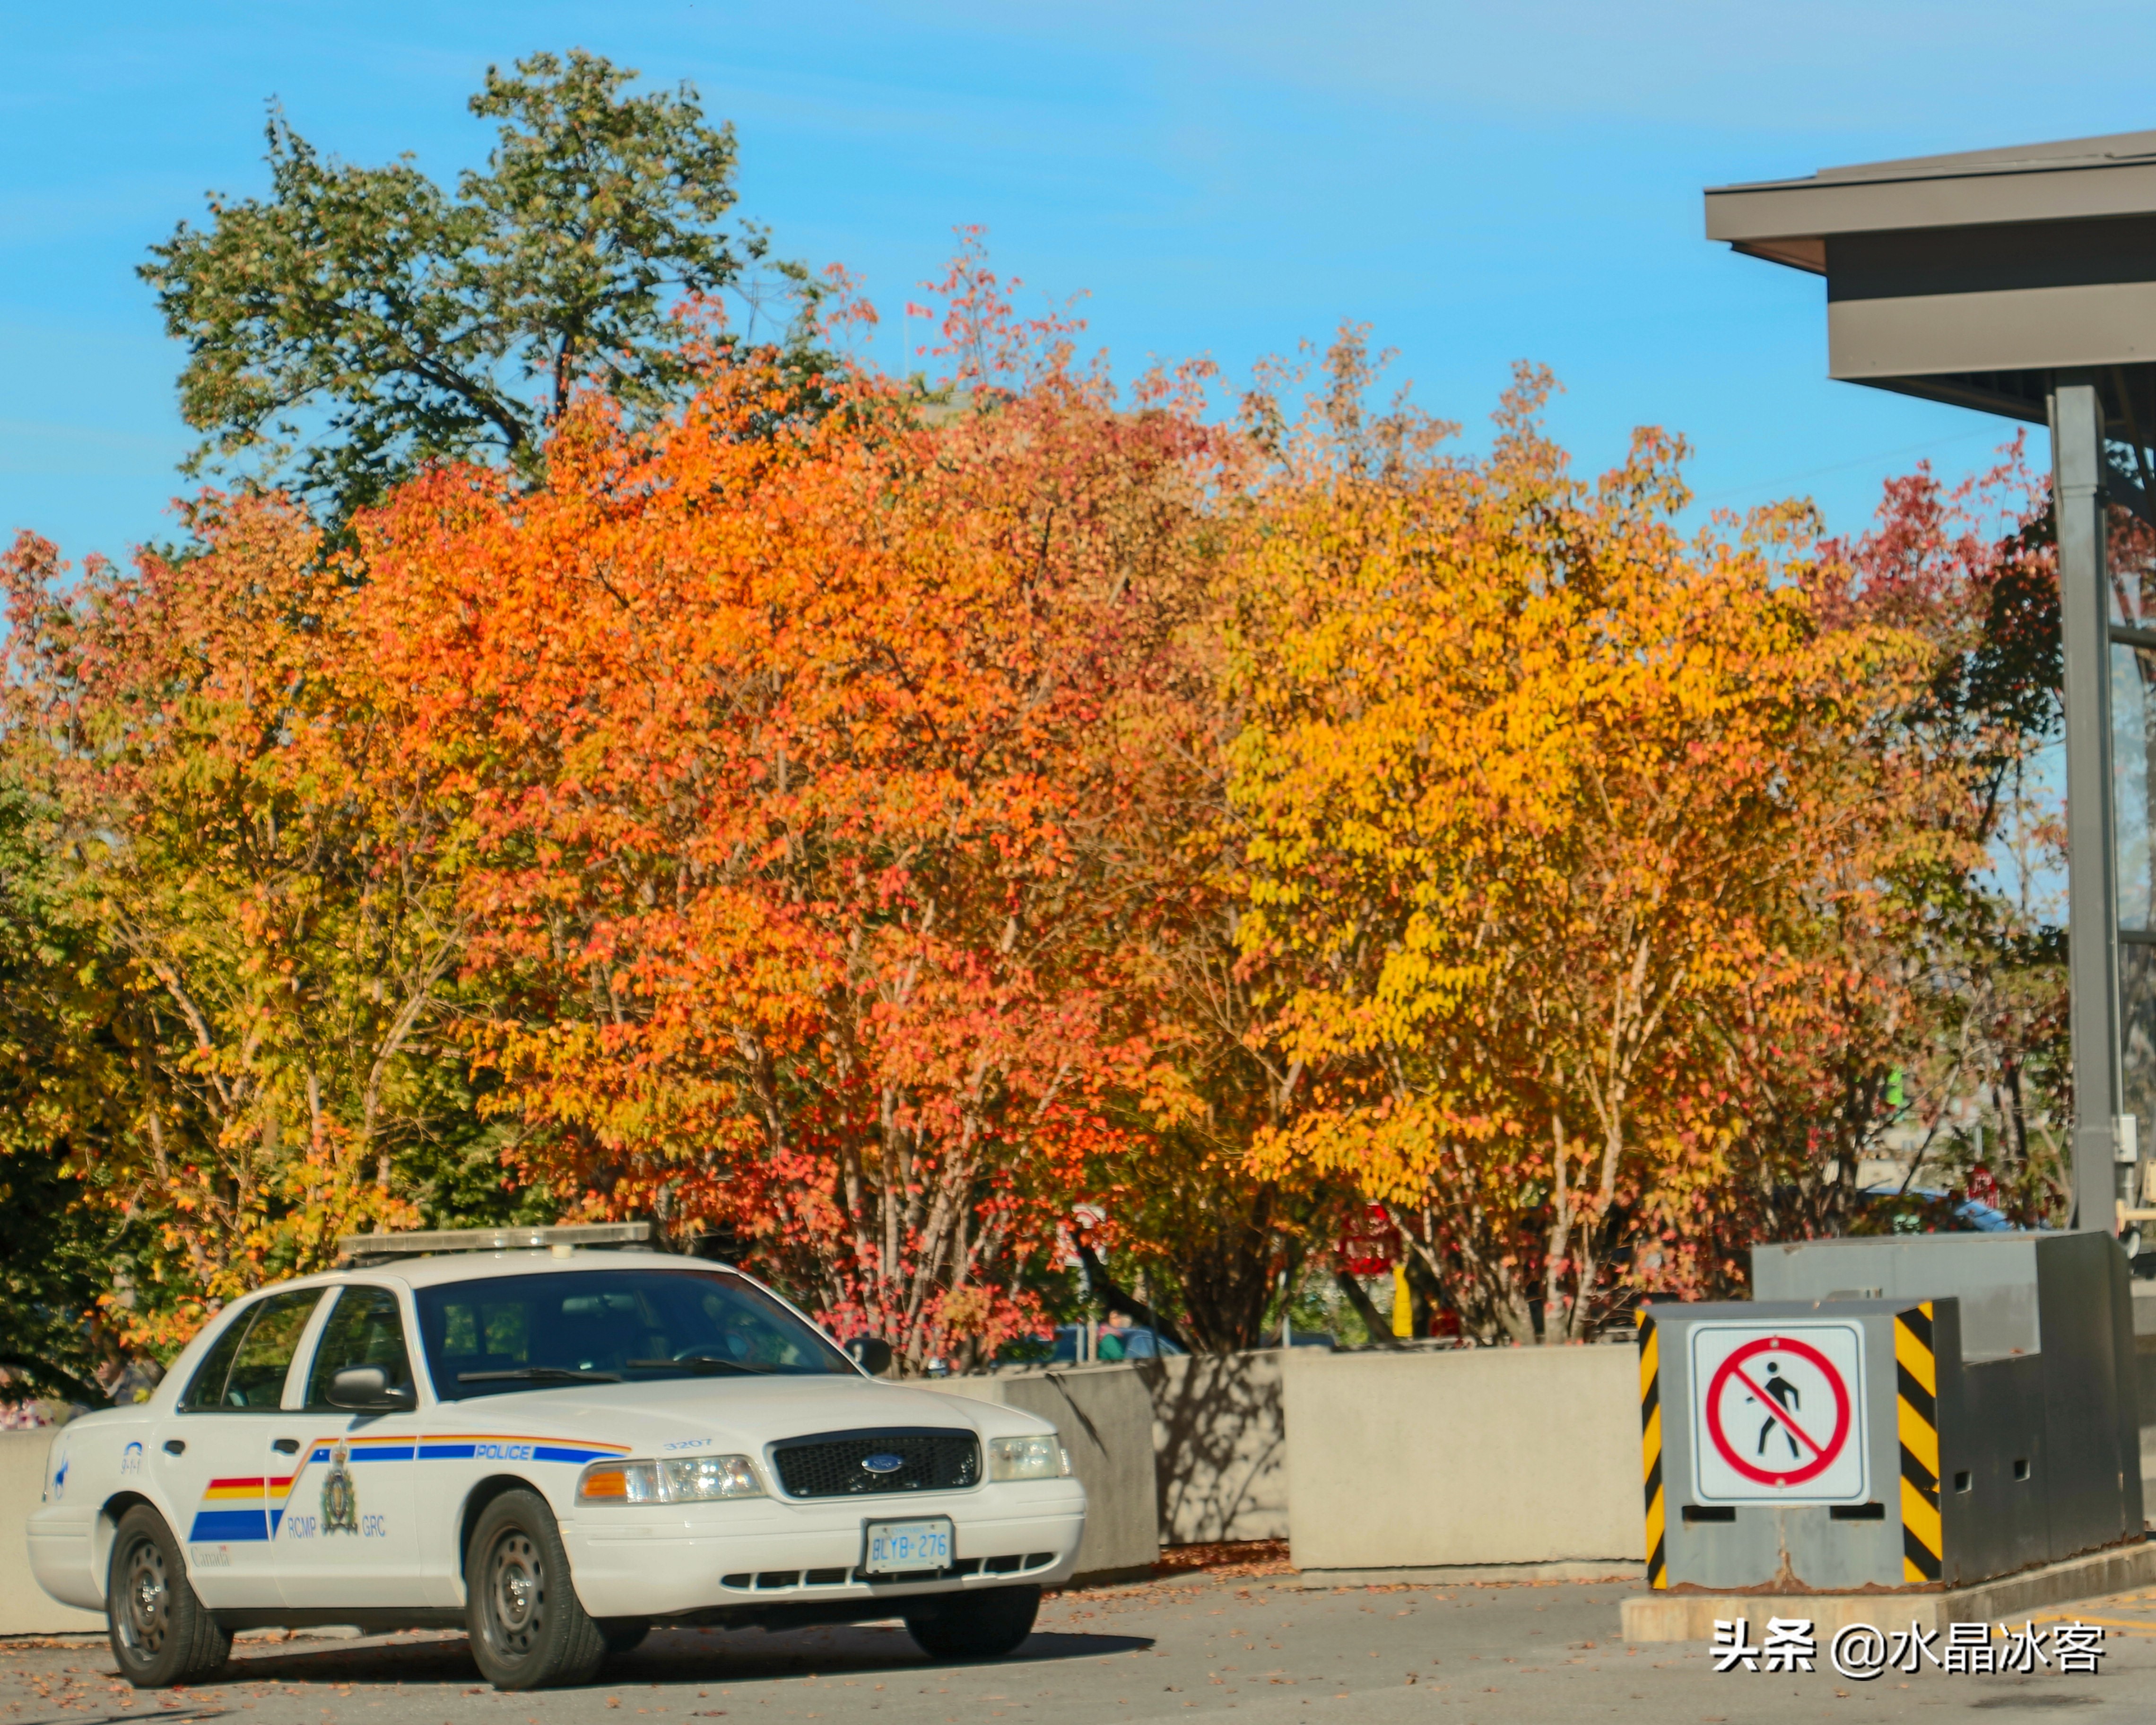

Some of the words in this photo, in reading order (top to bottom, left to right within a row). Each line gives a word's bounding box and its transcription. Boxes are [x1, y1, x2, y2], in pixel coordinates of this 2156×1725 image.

[476, 1445, 530, 1460] POLICE
[663, 1438, 712, 1451] 3207
[287, 1516, 316, 1538] RCMP
[362, 1515, 385, 1537] GRC
[191, 1545, 230, 1567] Canada
